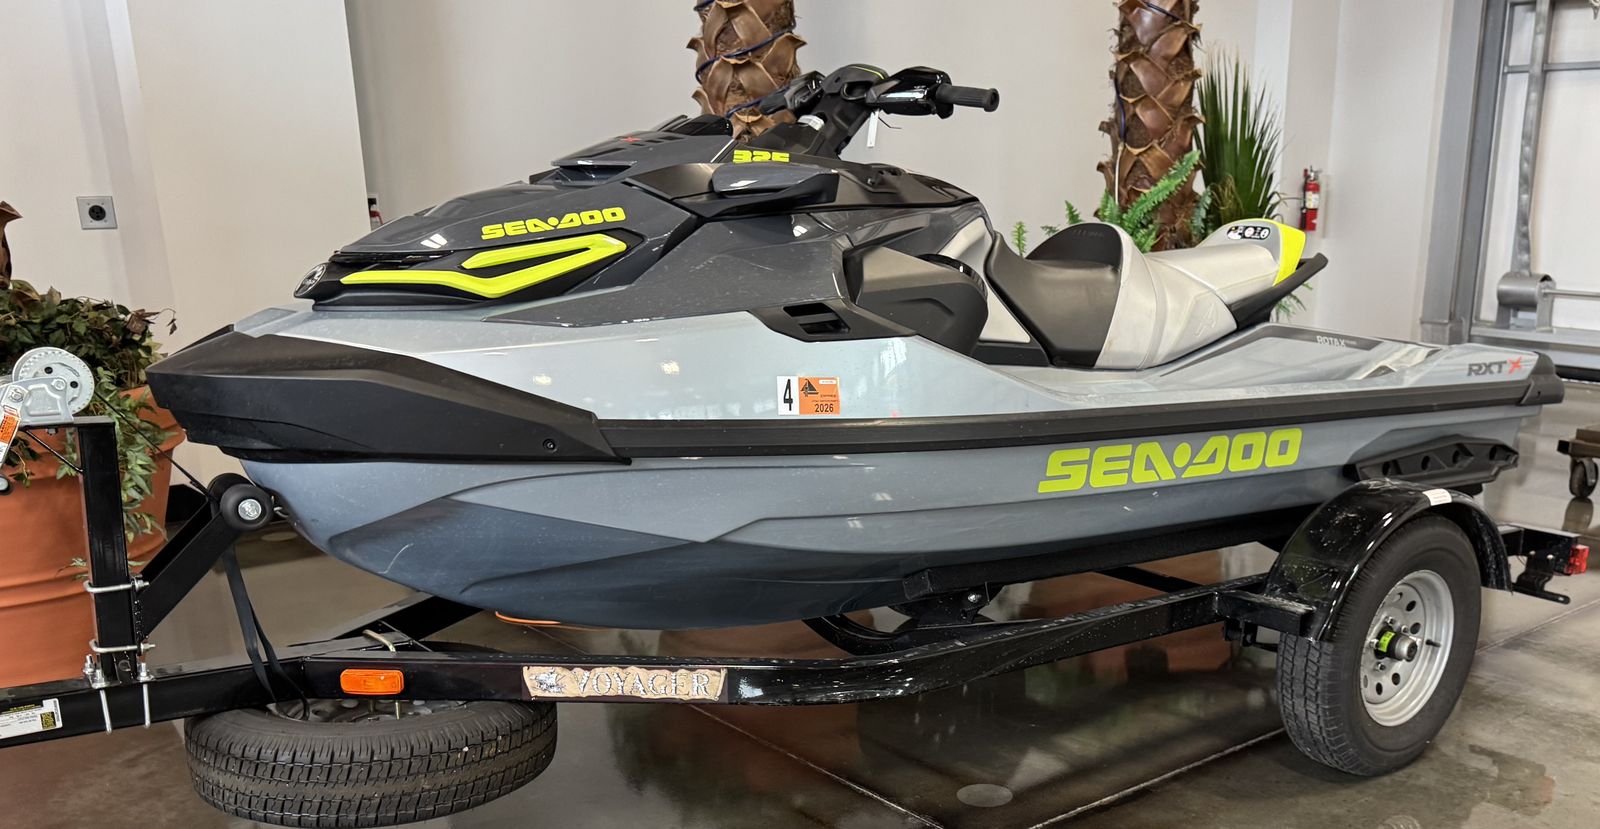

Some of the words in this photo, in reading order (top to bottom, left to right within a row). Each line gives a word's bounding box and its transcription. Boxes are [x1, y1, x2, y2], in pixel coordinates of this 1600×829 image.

[1316, 335, 1345, 347] ROTAX
[783, 378, 794, 411] 4
[815, 403, 834, 413] 2026
[571, 670, 710, 696] VOYAGER
